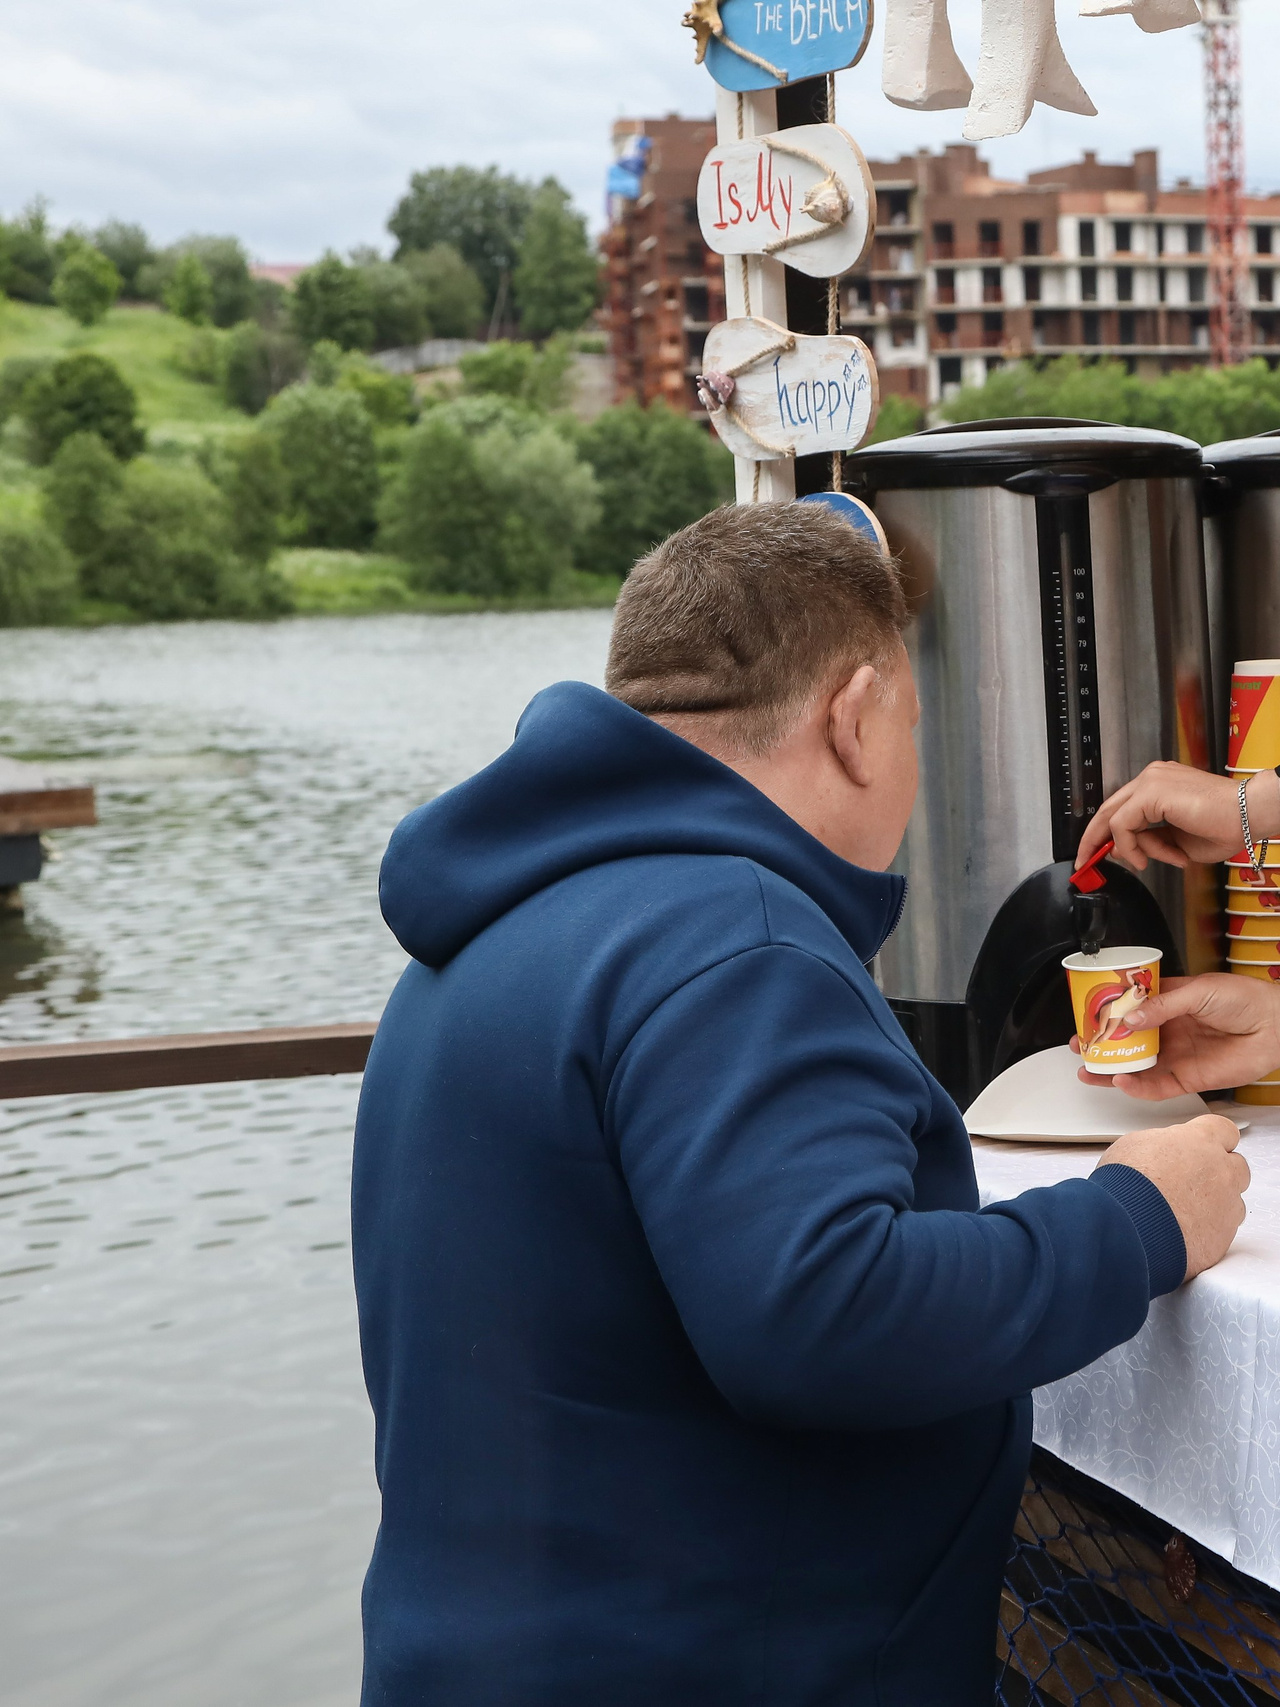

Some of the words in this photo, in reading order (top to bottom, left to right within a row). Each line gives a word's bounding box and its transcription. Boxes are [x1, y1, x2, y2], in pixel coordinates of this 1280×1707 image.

[754, 2, 783, 34] THE
[789, 0, 864, 45] BEACH
[710, 160, 743, 230] Is
[773, 355, 856, 436] happy
[1073, 568, 1086, 576] 100
[1075, 592, 1085, 600] 93
[1077, 616, 1086, 624] 86
[1083, 735, 1091, 743] 51
[1102, 1043, 1147, 1057] arlight
